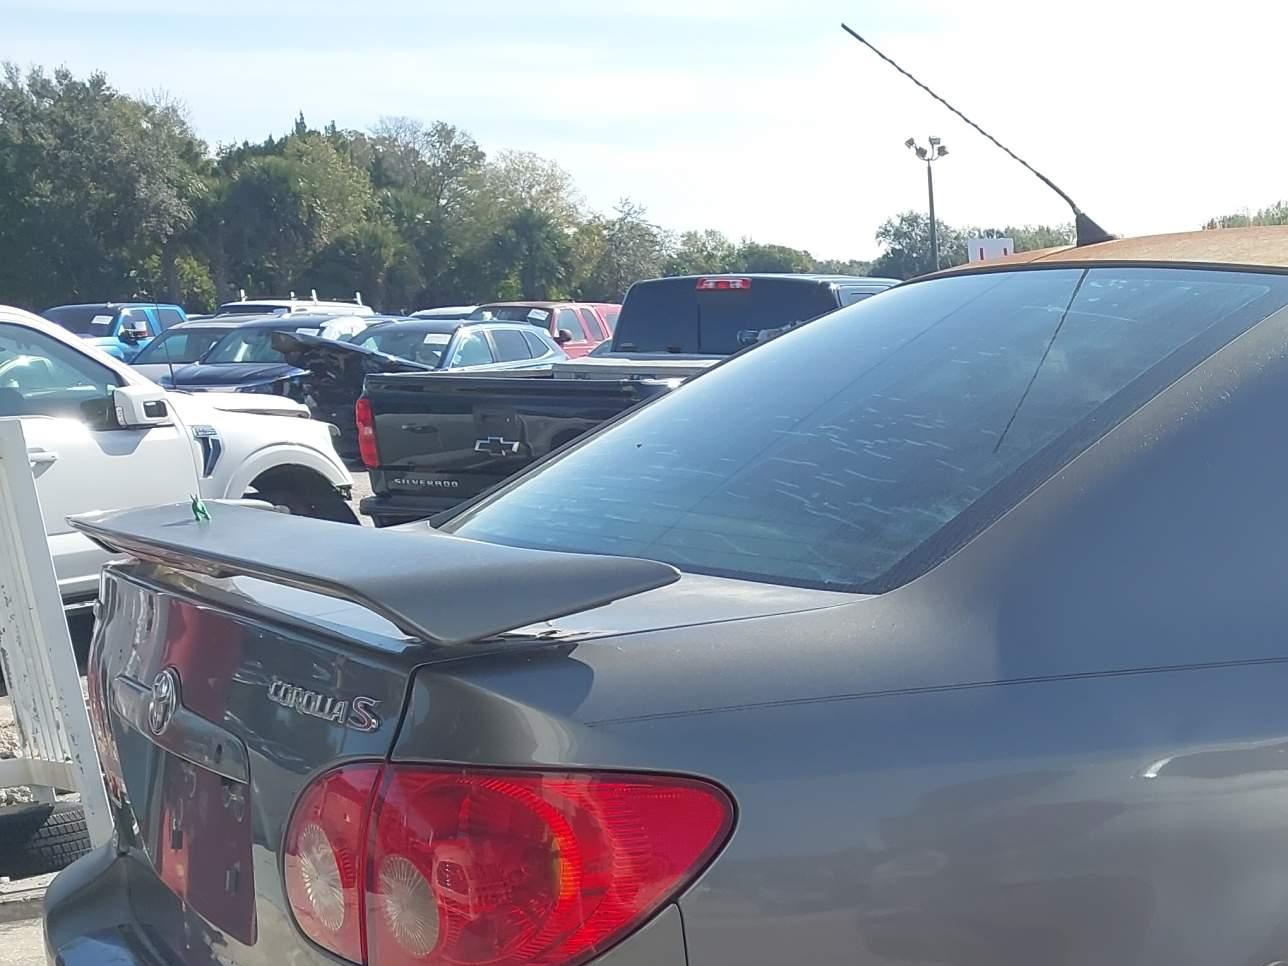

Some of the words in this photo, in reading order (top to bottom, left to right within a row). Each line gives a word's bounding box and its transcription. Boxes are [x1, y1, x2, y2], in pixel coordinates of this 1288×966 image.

[394, 478, 459, 488] SILVERADO
[267, 680, 348, 724] COROLLA
[347, 696, 383, 732] S
